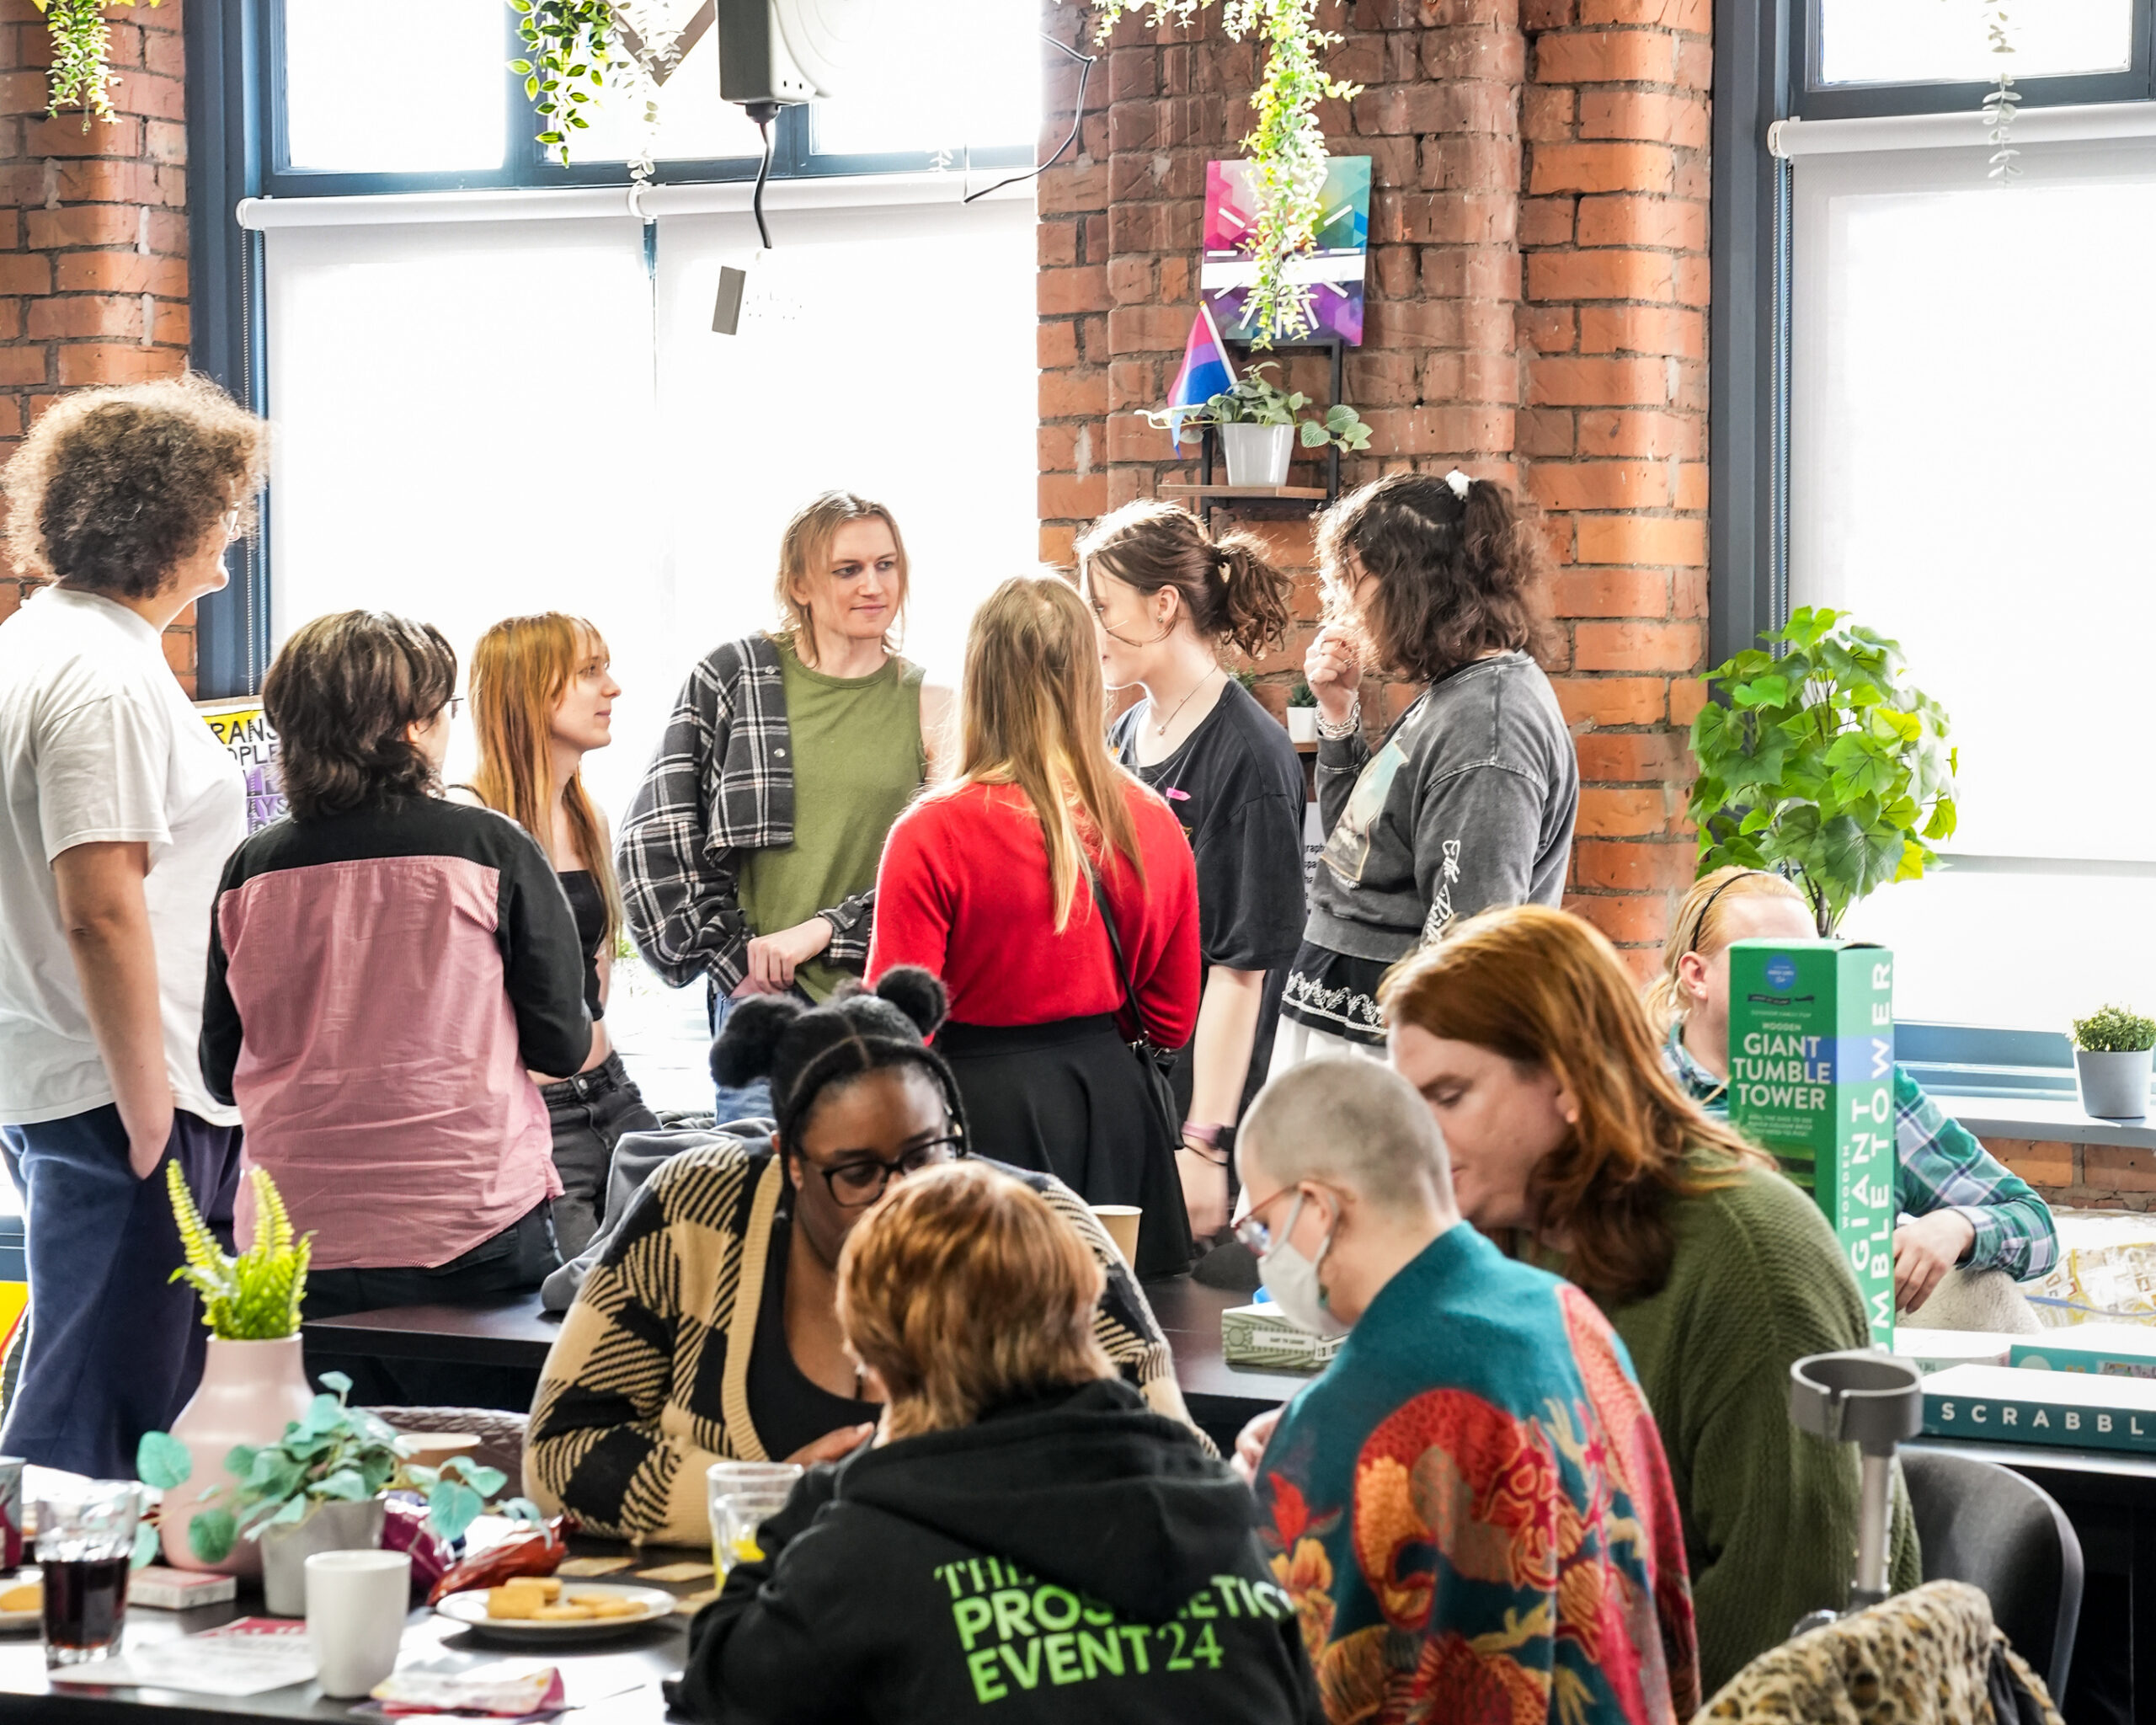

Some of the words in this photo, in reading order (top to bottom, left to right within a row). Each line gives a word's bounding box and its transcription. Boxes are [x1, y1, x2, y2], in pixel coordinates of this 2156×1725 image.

[1732, 1057, 1832, 1085] TUMBLE
[1743, 1033, 1821, 1058] GIANT
[1870, 963, 1892, 1157] TOWER
[1737, 1083, 1826, 1110] TOWER
[1842, 1145, 1850, 1230] WOODEN
[1851, 1097, 1871, 1272] GIANT
[1941, 1402, 2144, 1435] SCRABBL
[966, 1625, 1152, 1705] EVENT
[1156, 1621, 1225, 1671] 24
